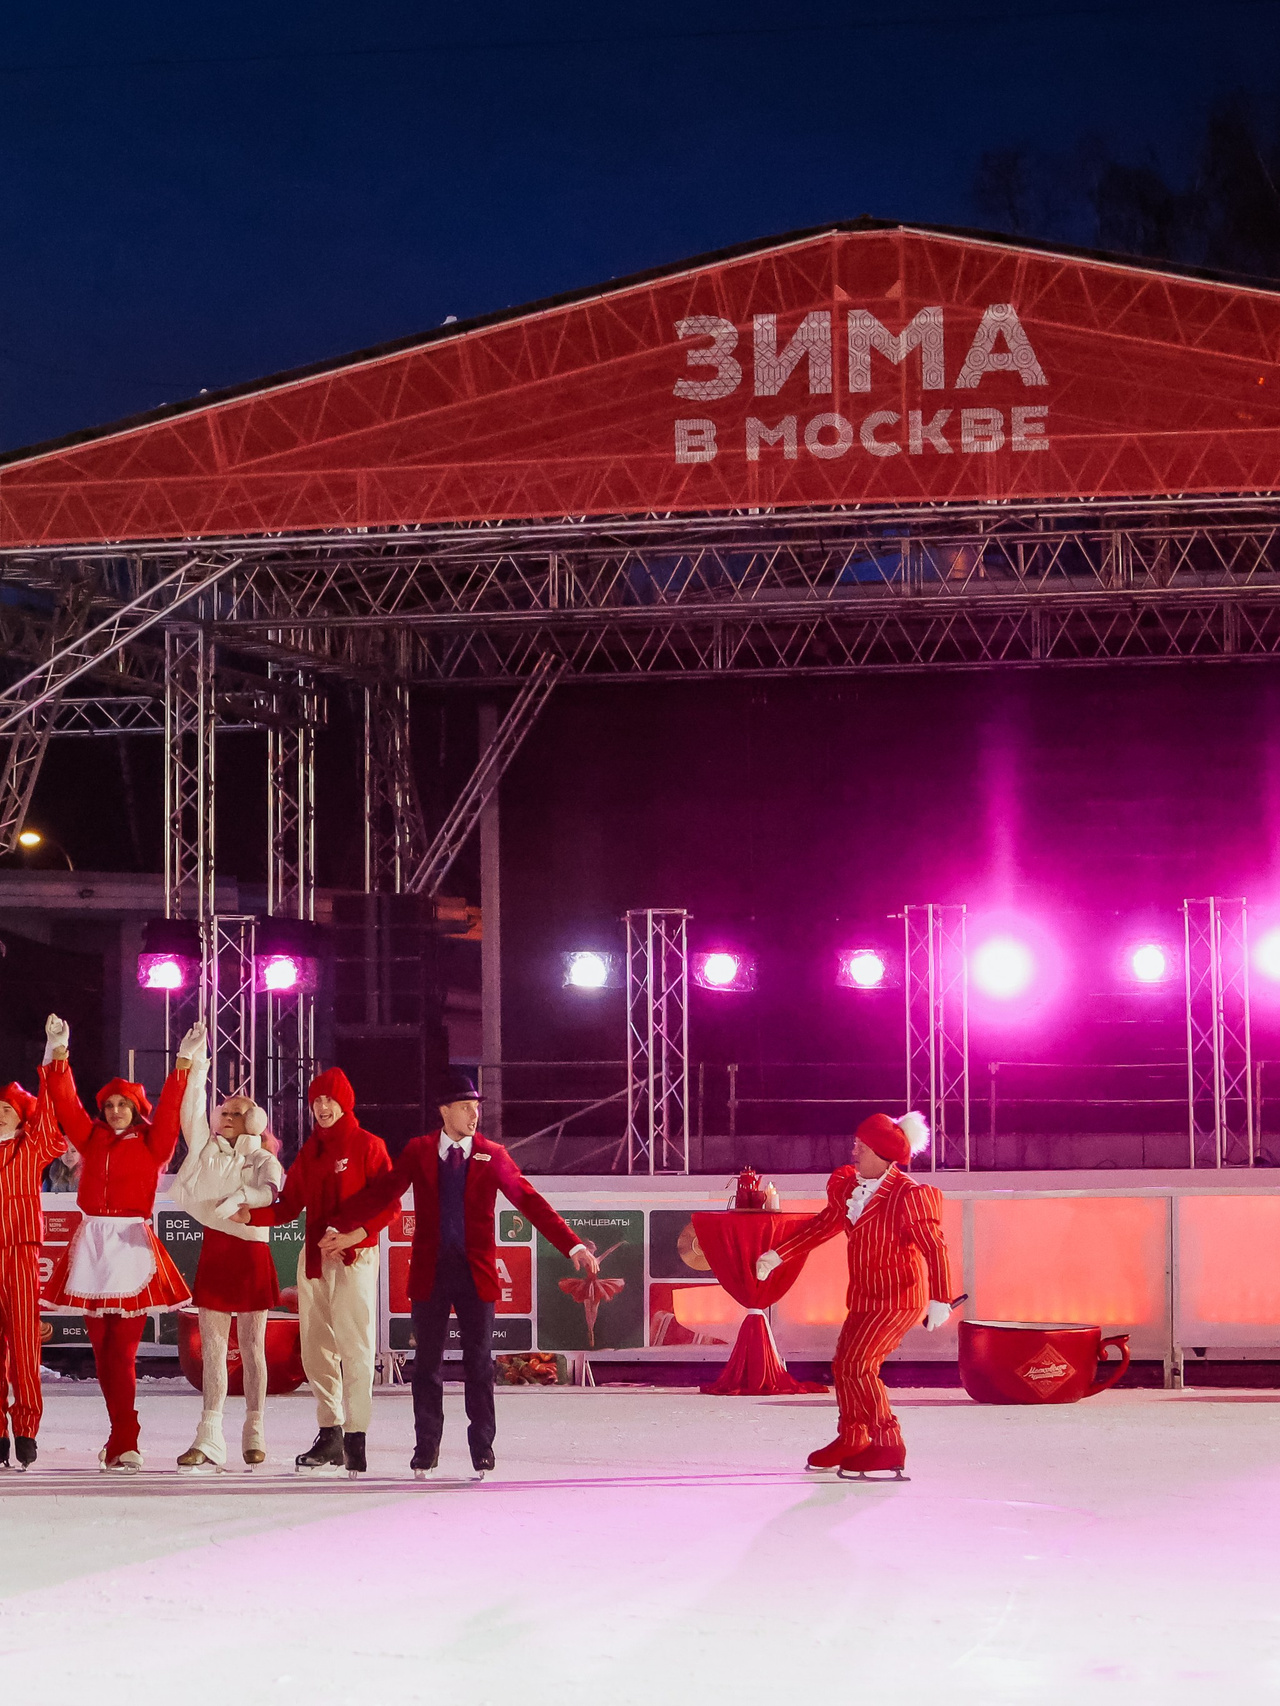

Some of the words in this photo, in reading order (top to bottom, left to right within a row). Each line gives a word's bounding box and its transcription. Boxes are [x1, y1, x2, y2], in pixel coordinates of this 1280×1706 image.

[672, 304, 1049, 401] ЗИМА
[675, 418, 718, 464] В
[745, 405, 1050, 462] МОСКВЕ
[166, 1219, 190, 1229] ВСЕ
[166, 1232, 174, 1241] В
[176, 1232, 204, 1241] ПАР
[273, 1232, 292, 1242] НА
[62, 1327, 81, 1336] ВСЕ
